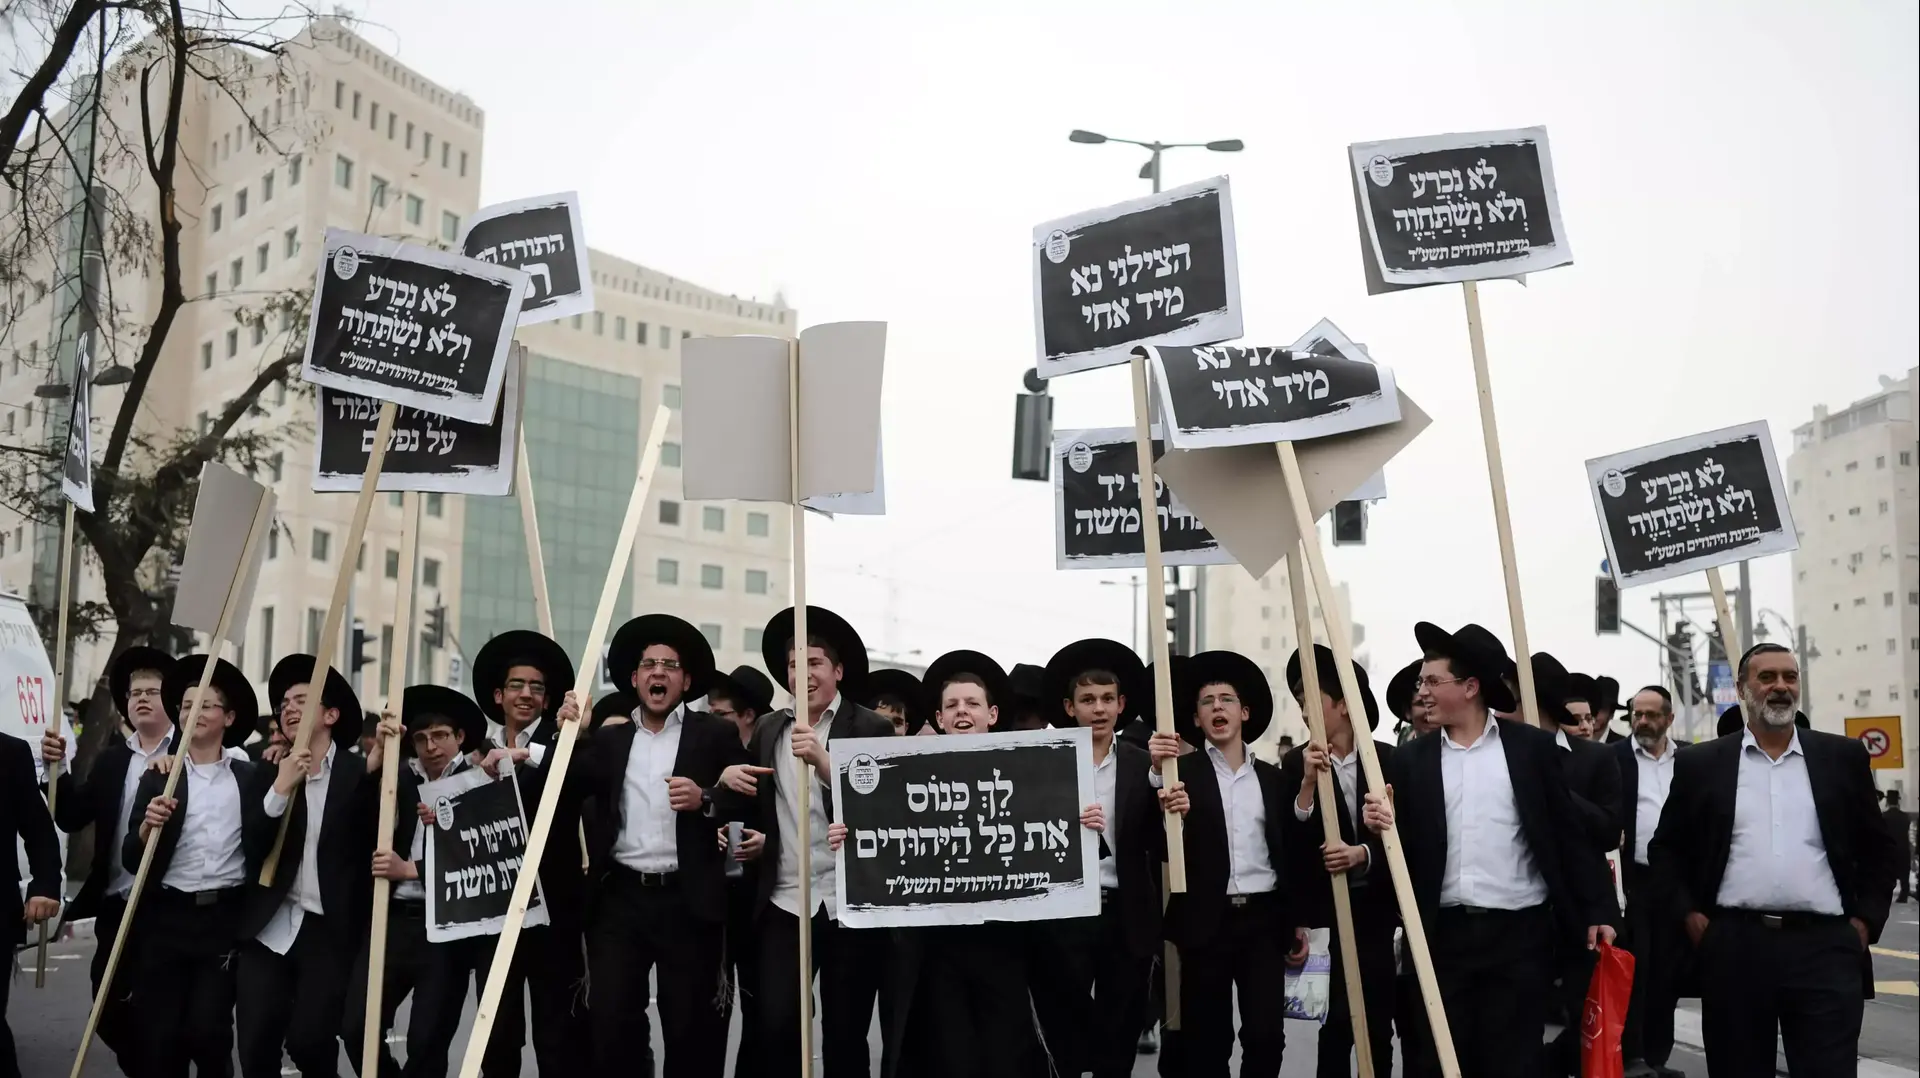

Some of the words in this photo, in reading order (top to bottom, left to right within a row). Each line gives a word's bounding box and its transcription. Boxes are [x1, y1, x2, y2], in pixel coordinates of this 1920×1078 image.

[500, 234, 564, 262] התורה
[1108, 242, 1192, 286] הצילני
[1451, 242, 1495, 258] היהודים
[1070, 263, 1103, 296] נא
[1082, 296, 1130, 332] אחי
[1136, 286, 1184, 321] מיד
[376, 360, 420, 384] היהודים
[1192, 347, 1231, 370] נא
[1212, 377, 1269, 409] אחי
[1272, 369, 1329, 404] מיד
[426, 422, 458, 456] על
[1098, 473, 1125, 501] יד
[1074, 506, 1140, 535] משה
[1687, 532, 1728, 551] היהודים
[17, 676, 45, 724] 667
[460, 826, 479, 858] יד
[480, 816, 526, 854] הרימו
[444, 864, 496, 902] משה
[943, 874, 1002, 894] היהודים
[1004, 872, 1050, 891] מדינת
